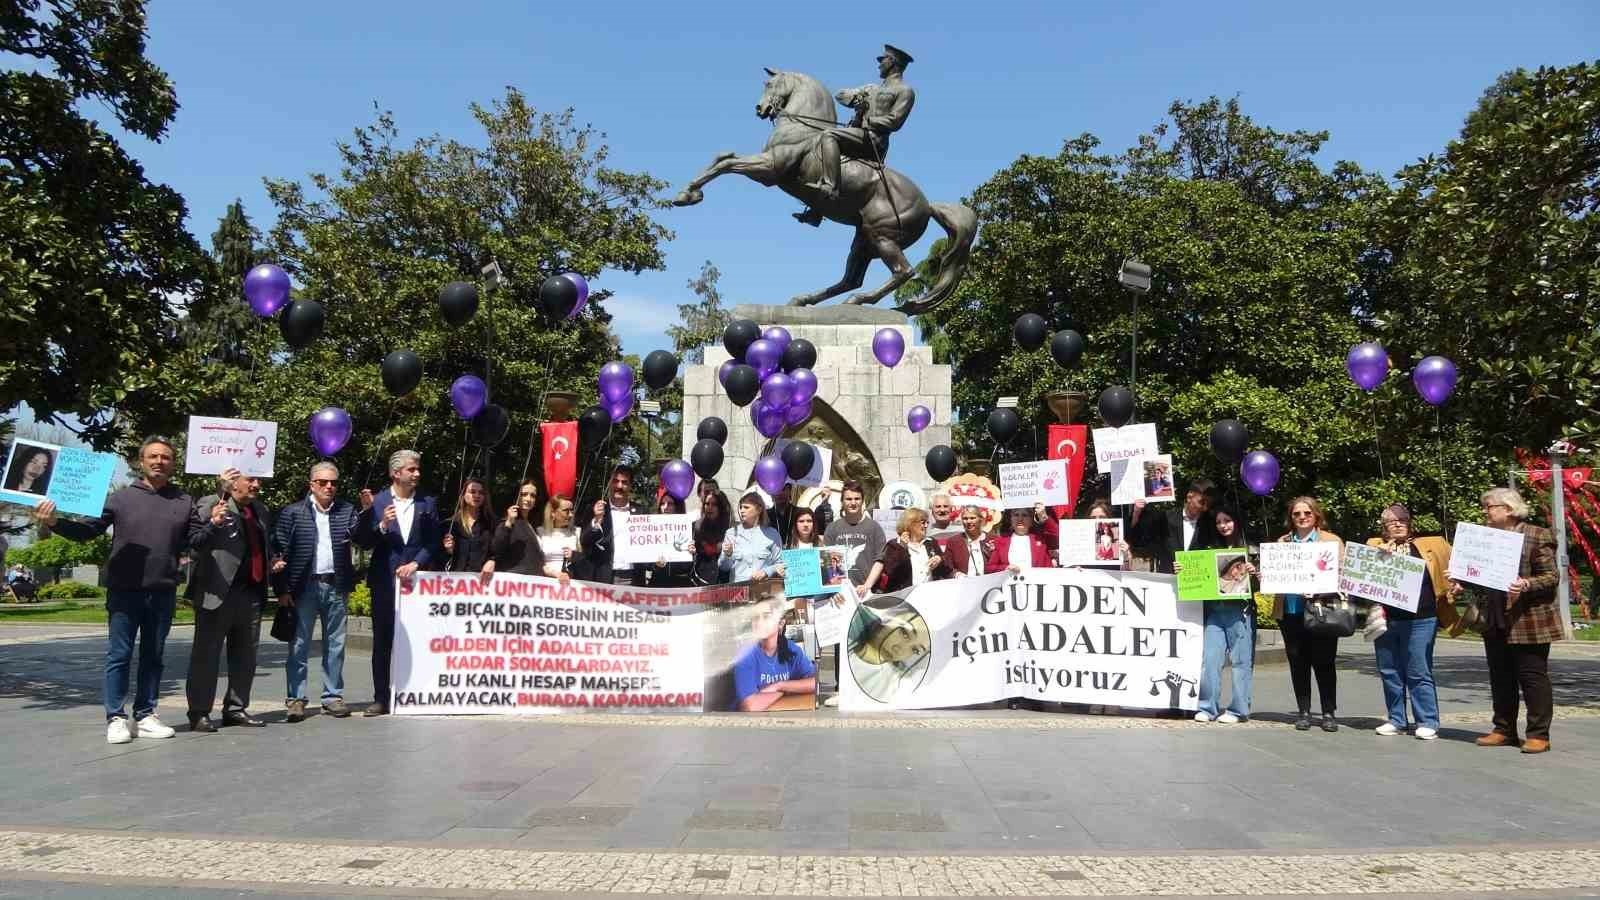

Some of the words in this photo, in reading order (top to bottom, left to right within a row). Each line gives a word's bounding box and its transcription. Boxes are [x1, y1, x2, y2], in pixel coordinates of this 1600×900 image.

[980, 575, 1149, 616] GÜLDEN
[429, 602, 450, 617] 30
[456, 602, 506, 619] BIÇAK
[509, 604, 608, 622] DARBESİNİN
[465, 620, 473, 634] 1
[479, 620, 532, 636] YILDIR
[536, 622, 638, 639] SORULMADI!
[430, 635, 497, 653] GÜLDEN
[502, 635, 534, 655] İÇİN
[538, 639, 604, 656] ADALET
[608, 642, 669, 657] GELENE
[951, 625, 1009, 663] için
[1017, 622, 1187, 658] ADALET
[446, 655, 505, 670] KADAR
[509, 657, 654, 673] SOKAKLARDAYIZ.
[438, 673, 461, 688] BU
[465, 673, 516, 689] KANLI
[521, 674, 577, 690] HESAP
[1005, 659, 1128, 693] istiyoruz
